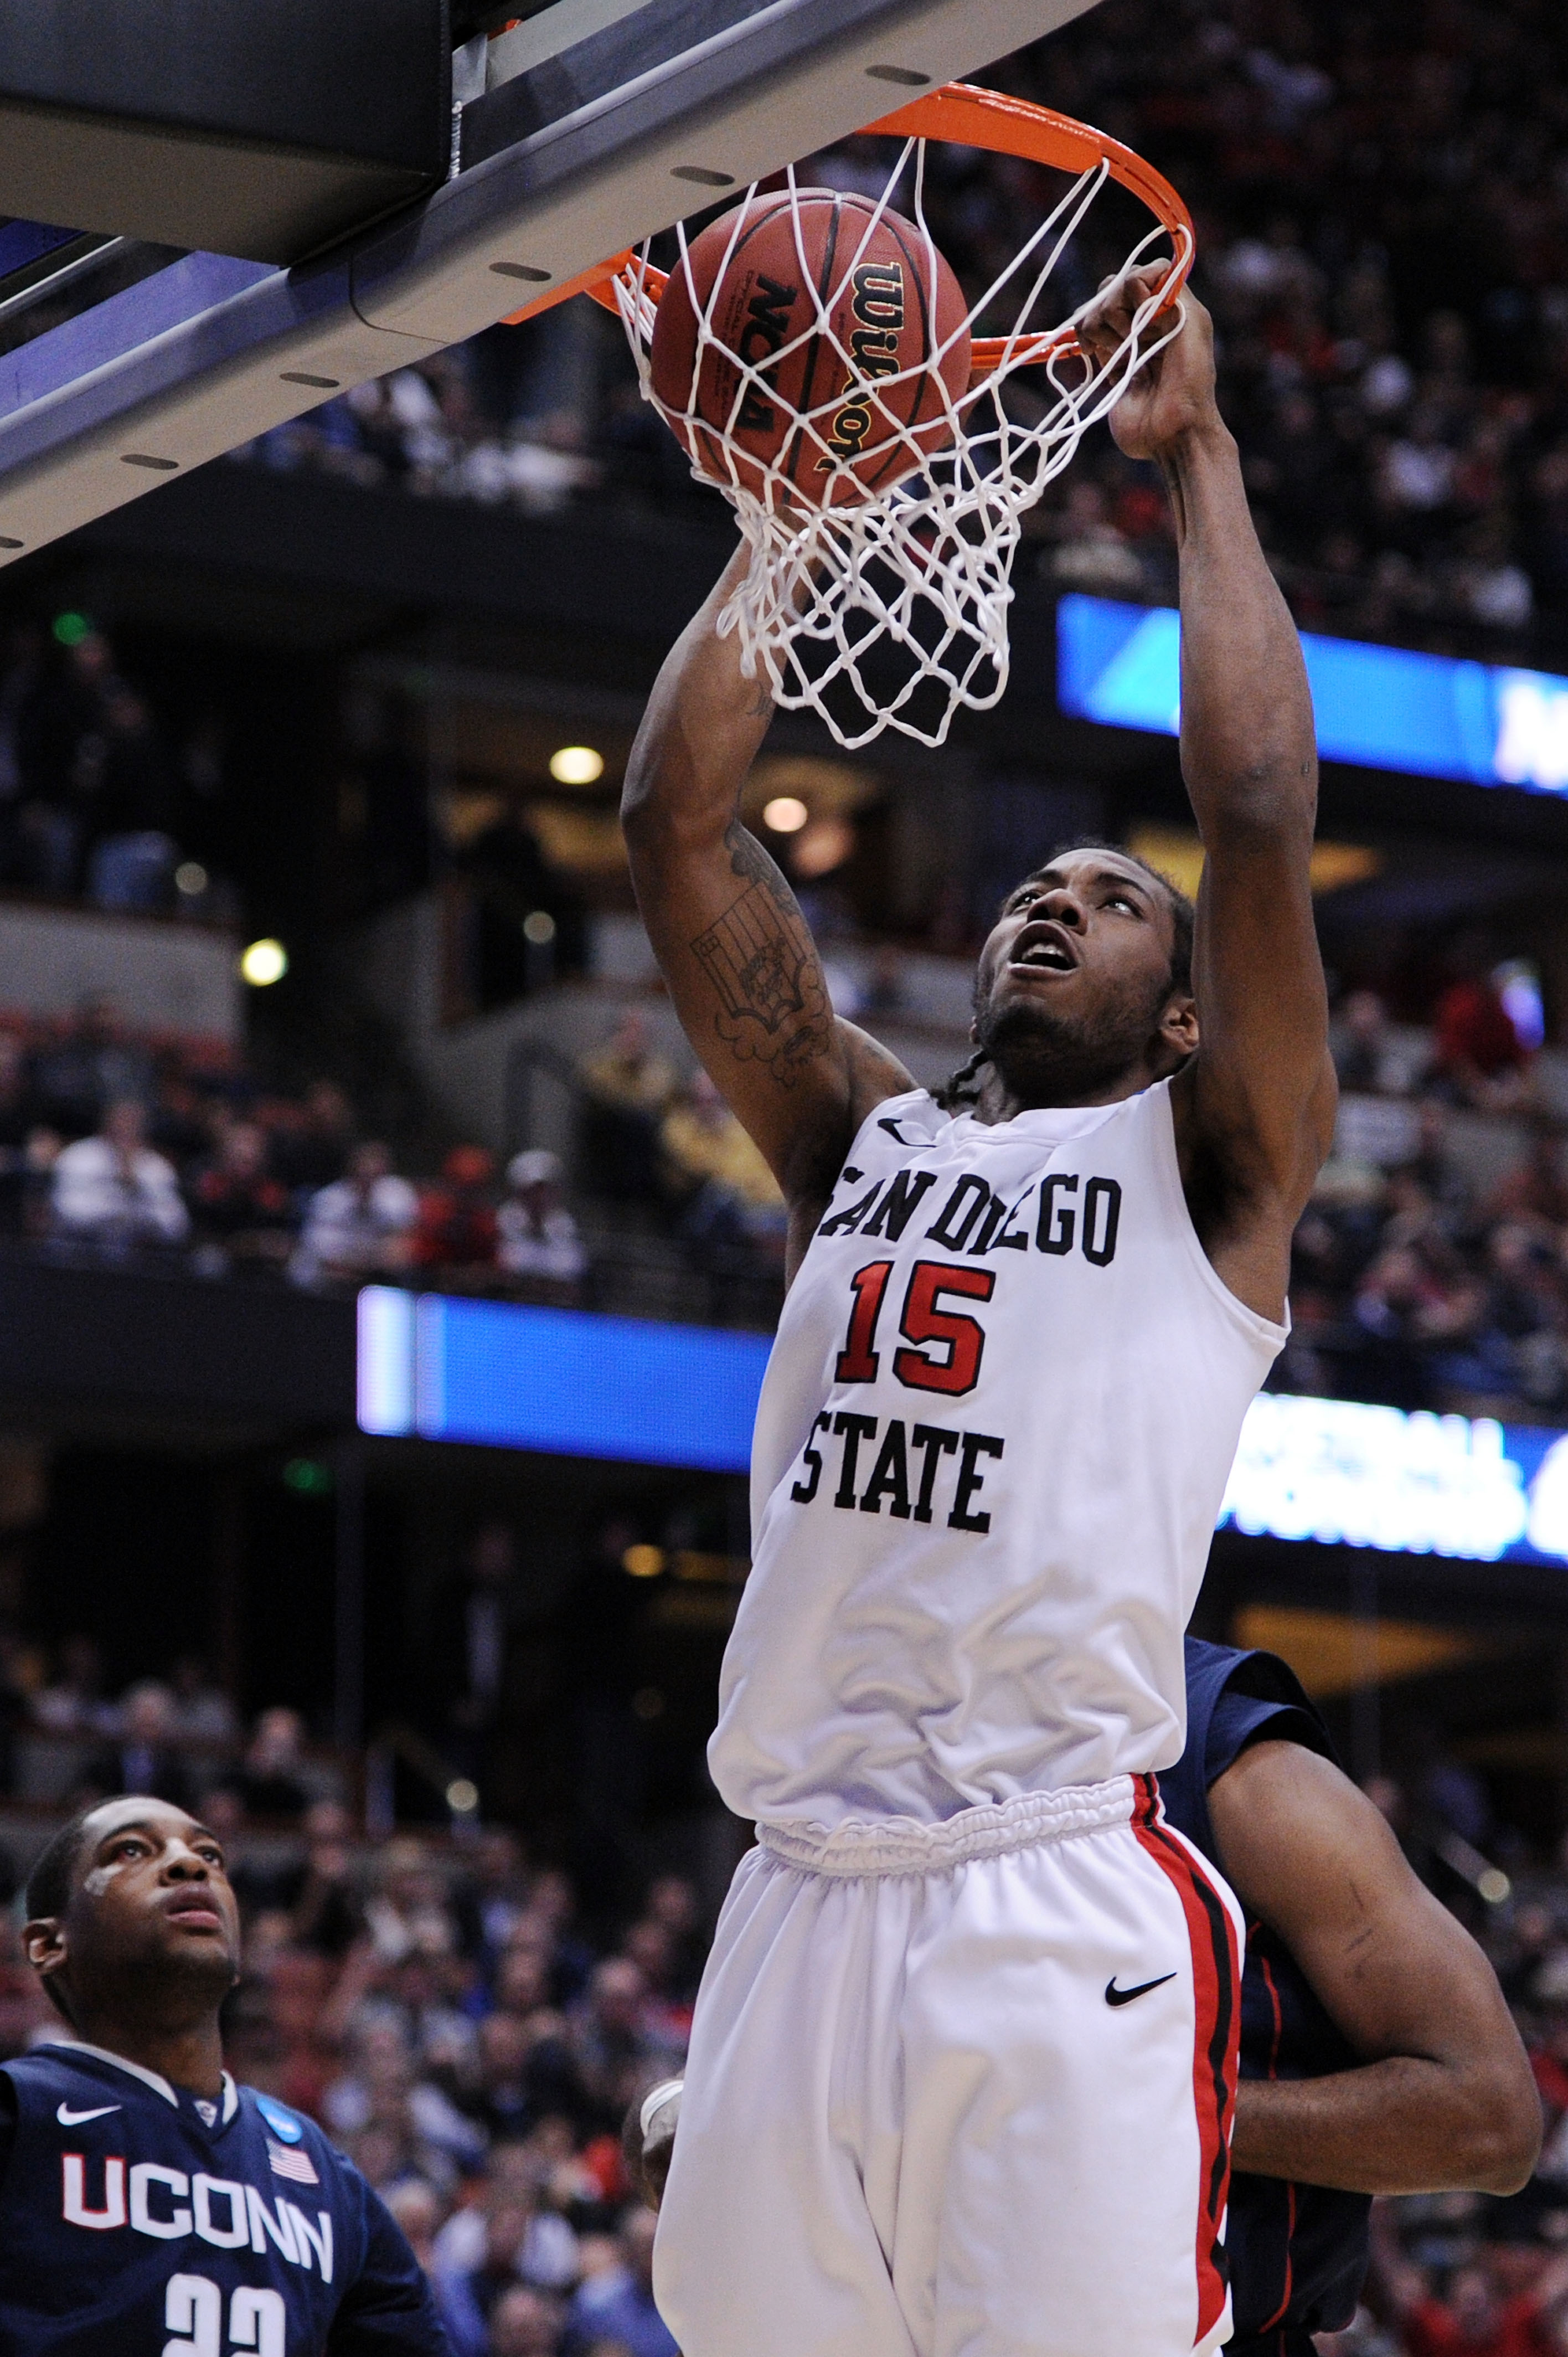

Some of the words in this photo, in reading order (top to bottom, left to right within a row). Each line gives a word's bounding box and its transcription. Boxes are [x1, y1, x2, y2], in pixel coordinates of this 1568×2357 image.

[813, 261, 905, 472] Wilson
[834, 1260, 997, 1397] 15
[790, 1411, 1005, 1534] STATE
[61, 2152, 333, 2284] UCONN
